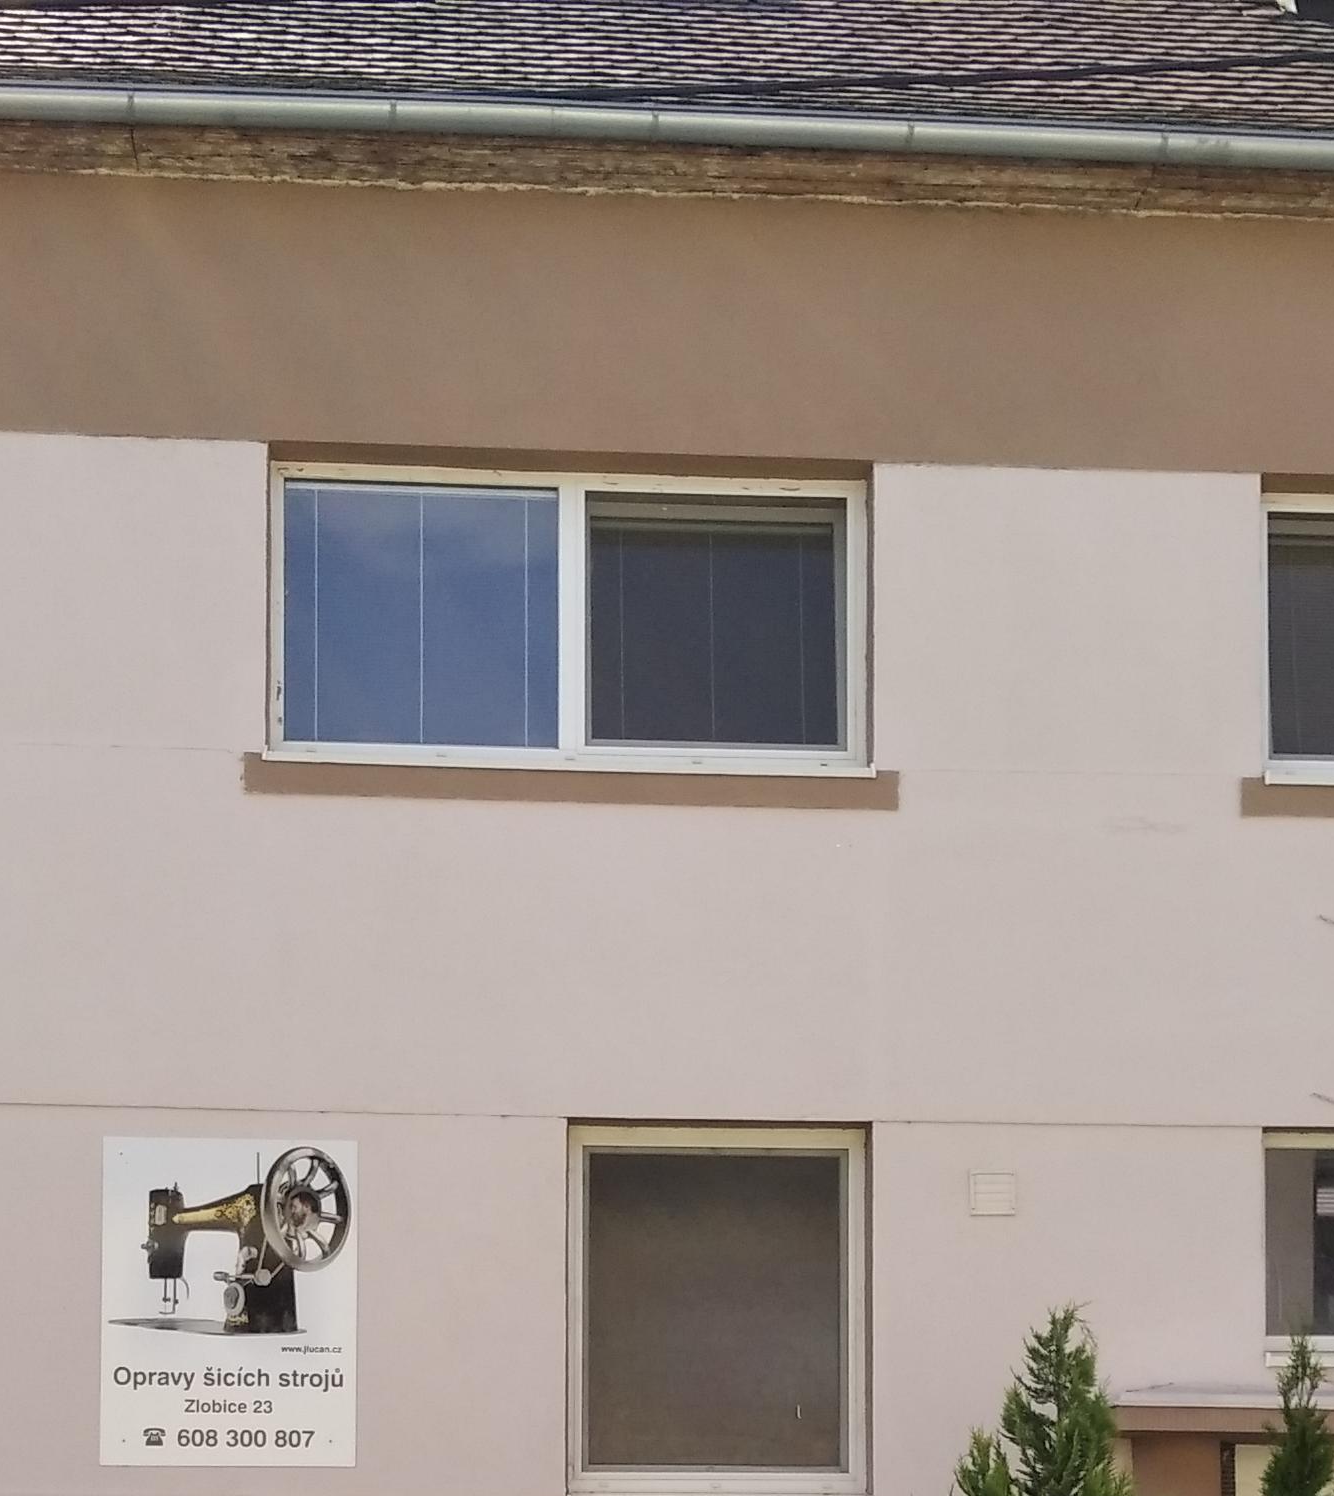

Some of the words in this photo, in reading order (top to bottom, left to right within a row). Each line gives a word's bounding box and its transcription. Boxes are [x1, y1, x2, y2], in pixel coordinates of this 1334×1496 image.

[113, 1366, 195, 1391] Opravy
[203, 1366, 270, 1387] šicích
[278, 1368, 344, 1392] strojů
[184, 1399, 248, 1414] Zlobice
[253, 1400, 273, 1414] 23
[177, 1429, 218, 1447] 608
[226, 1429, 267, 1448] 300
[274, 1430, 316, 1448] 807
